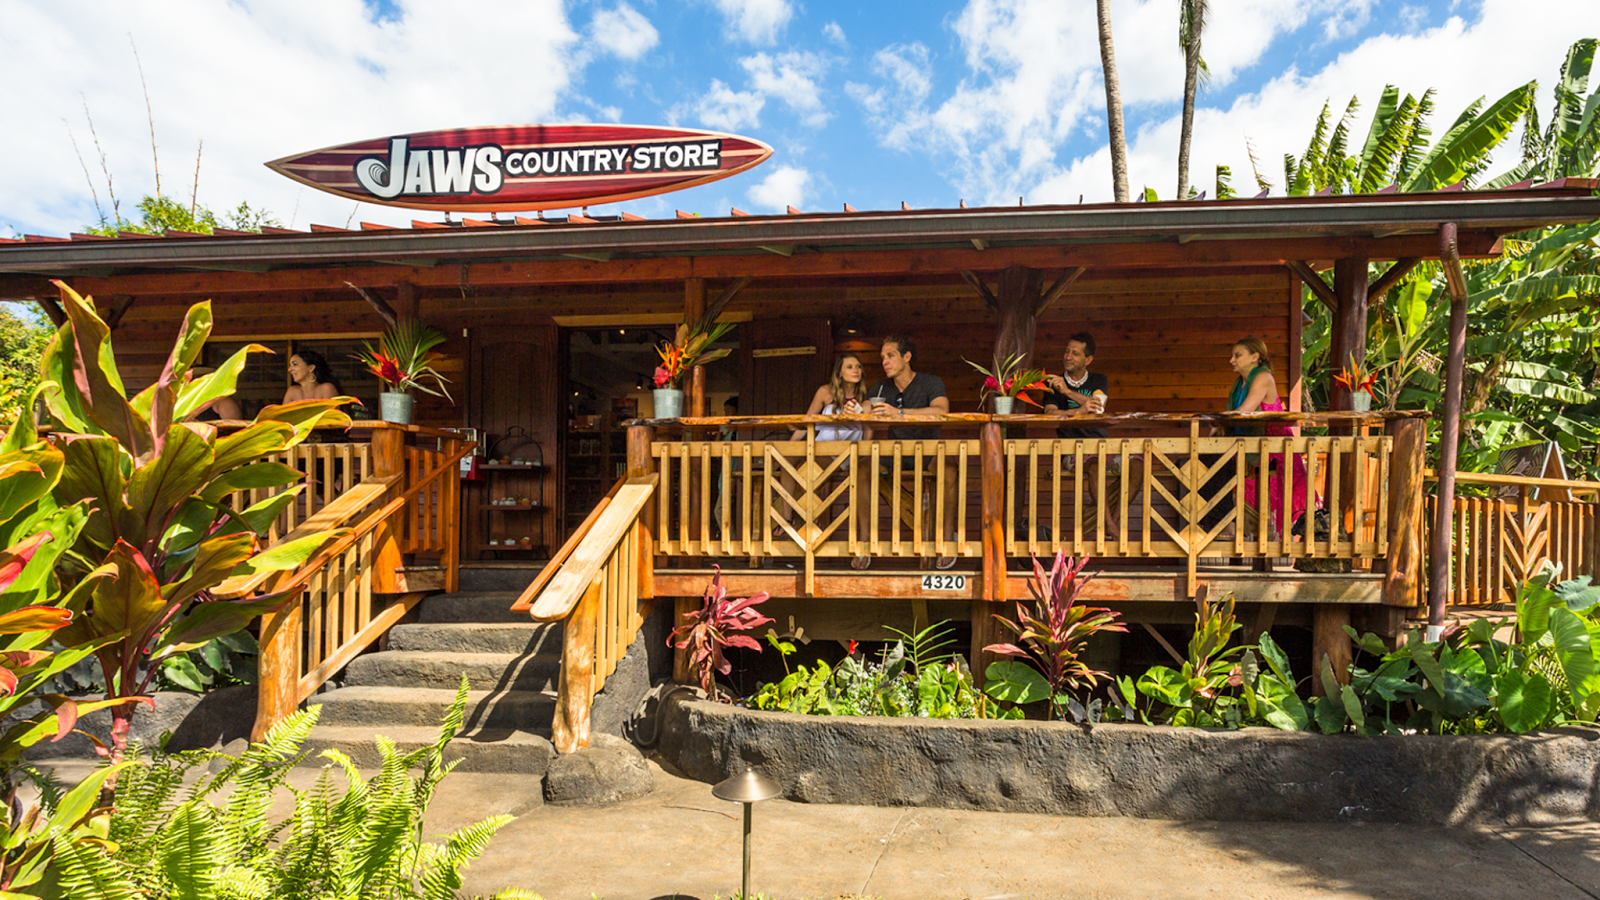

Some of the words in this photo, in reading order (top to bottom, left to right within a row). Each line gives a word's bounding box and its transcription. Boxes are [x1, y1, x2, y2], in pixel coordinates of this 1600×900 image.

[356, 138, 502, 198] JAWS
[506, 148, 629, 175] COUNTRY
[633, 142, 719, 170] STORE
[923, 575, 965, 589] 4320
